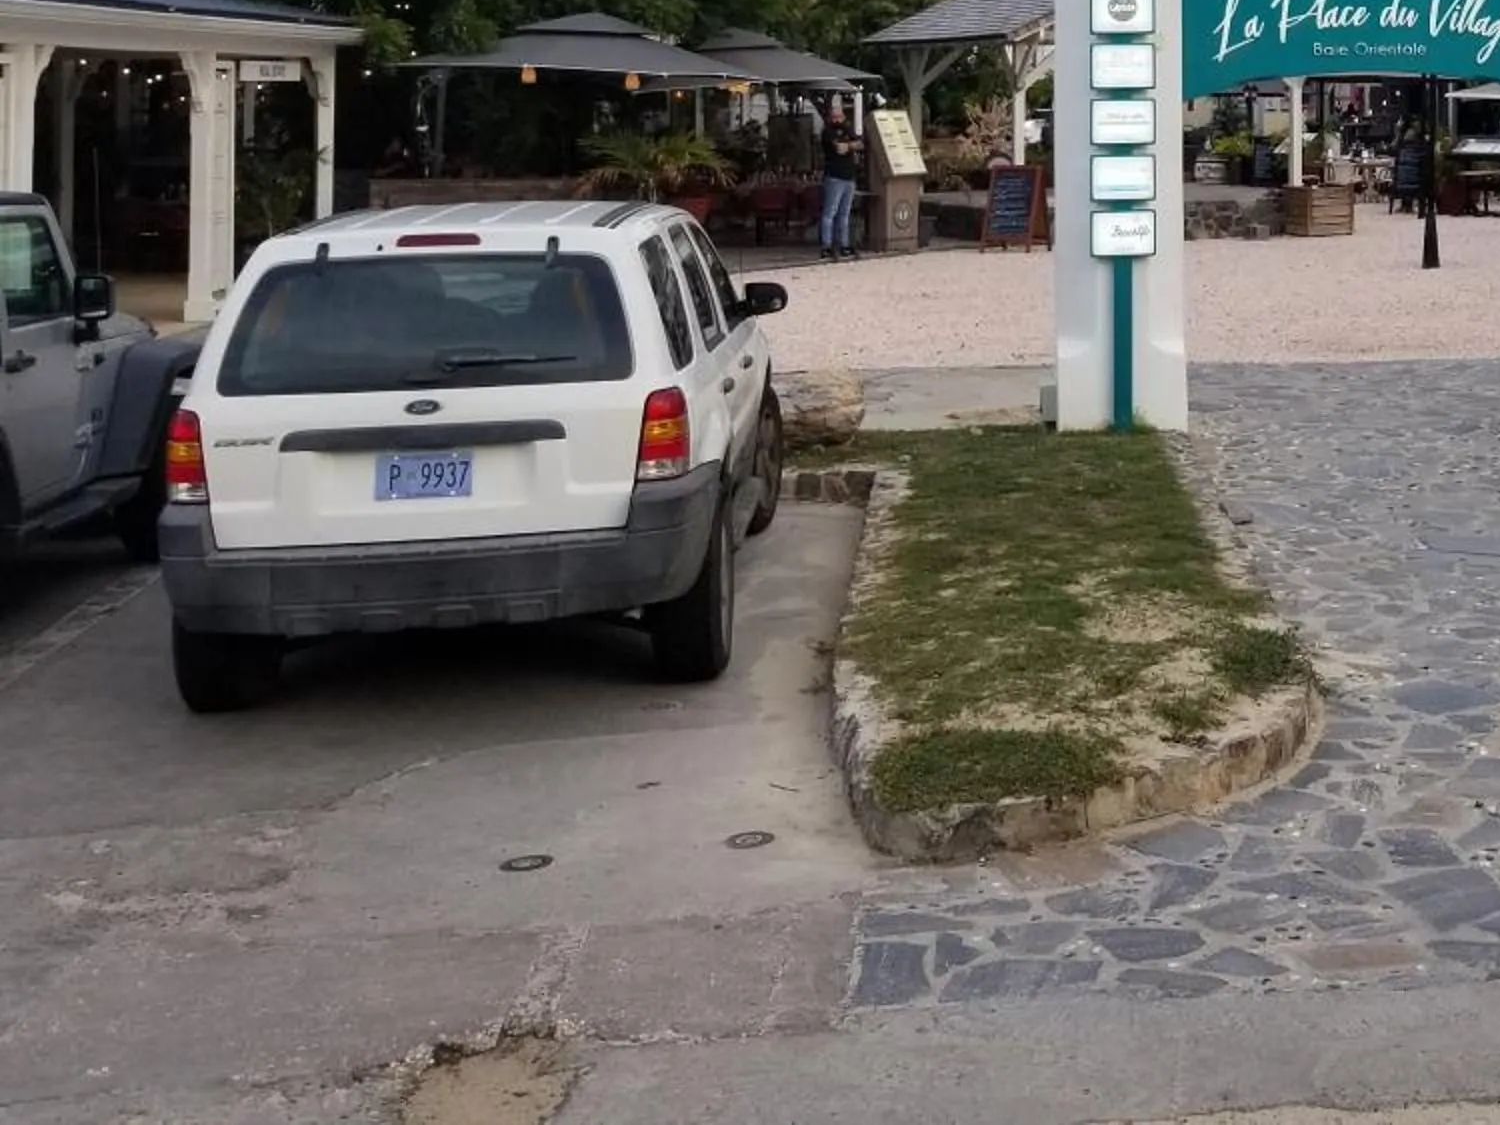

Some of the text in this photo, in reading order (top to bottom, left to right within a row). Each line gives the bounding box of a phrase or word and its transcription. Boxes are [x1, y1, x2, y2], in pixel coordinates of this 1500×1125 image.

[1313, 42, 1427, 56] Baie Orientale
[388, 461, 470, 491] P 9937
